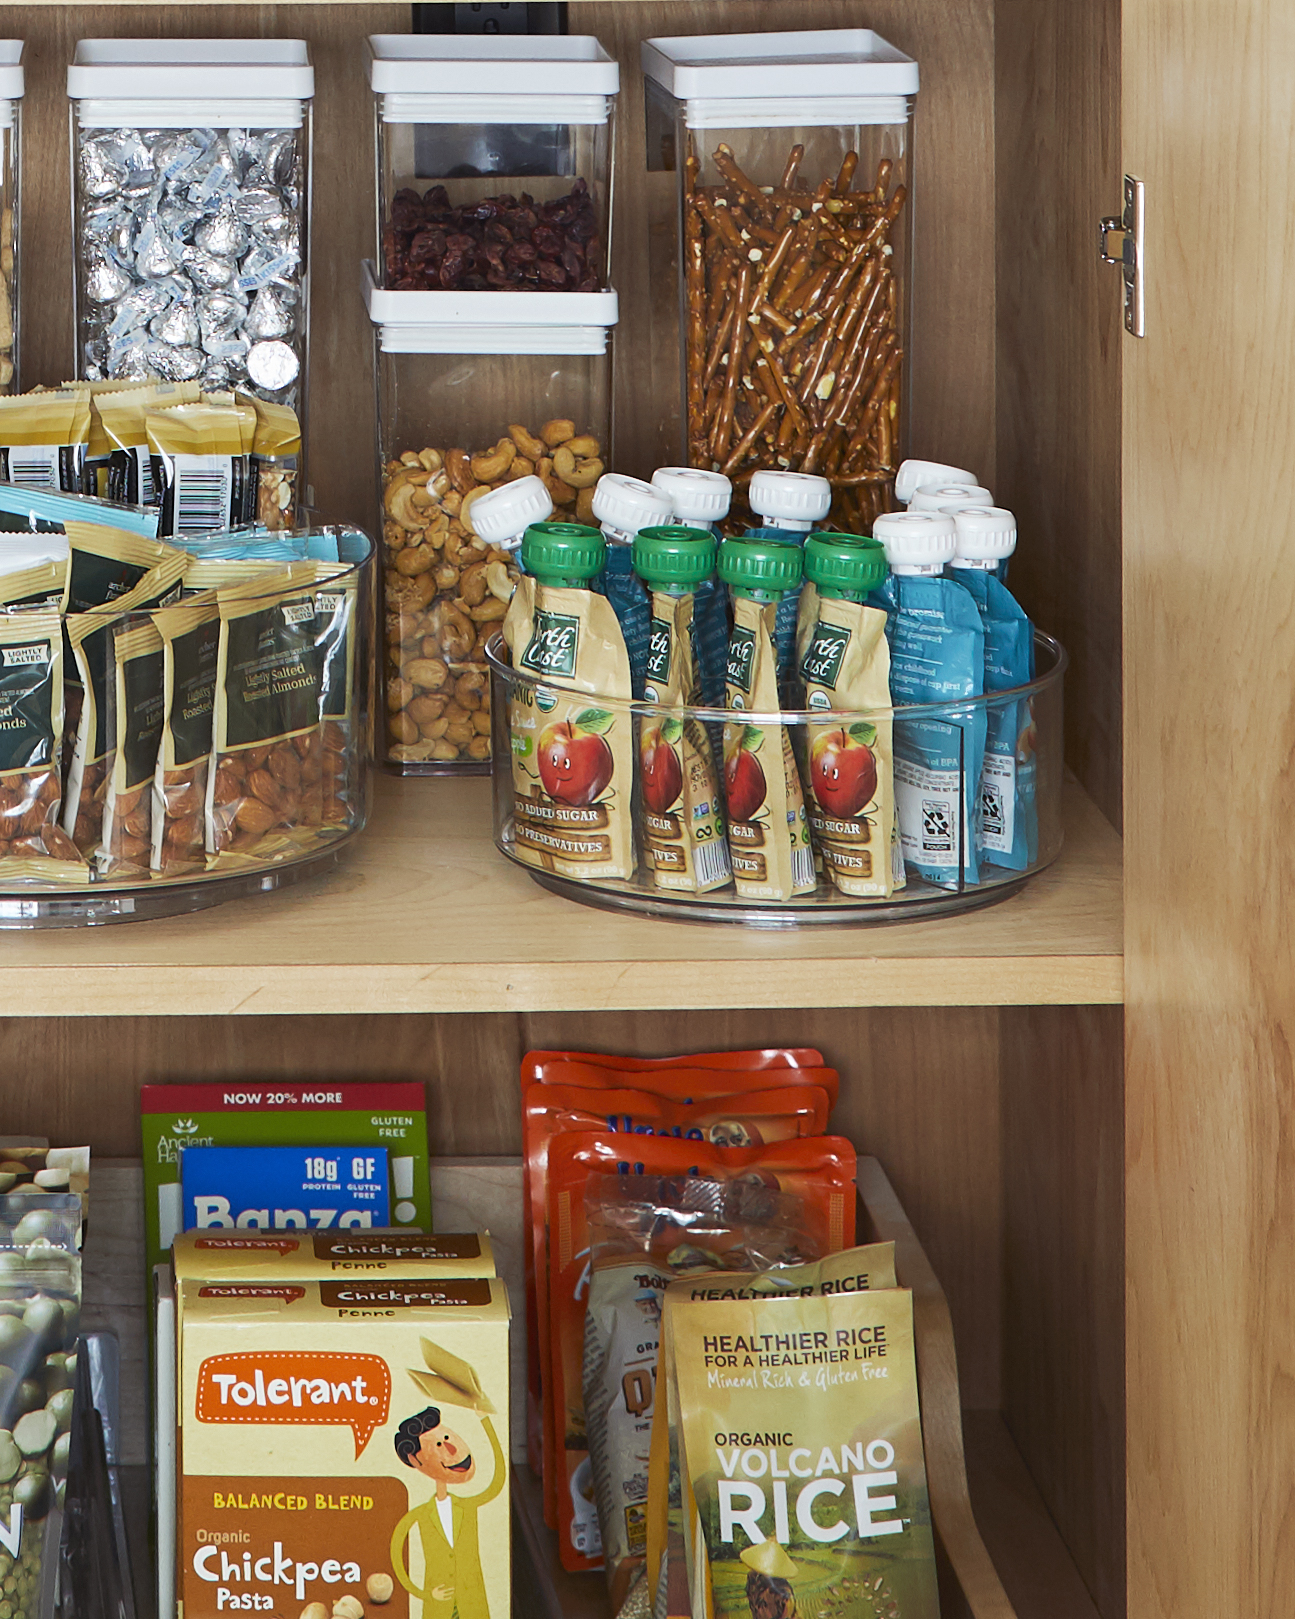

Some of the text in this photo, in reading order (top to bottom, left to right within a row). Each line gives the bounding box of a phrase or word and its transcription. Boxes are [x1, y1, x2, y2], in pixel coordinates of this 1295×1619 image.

[8, 647, 43, 658] LIGHTLY
[10, 655, 43, 664] SALTED
[271, 663, 306, 681] Salted
[940, 758, 959, 767] BPA
[556, 809, 599, 822] SUGAR
[525, 827, 603, 853] PRESERVATIVES
[223, 1092, 342, 1105] NOW 20% MORE
[370, 1116, 413, 1126] GLUTEN
[378, 1127, 407, 1138] FREE
[304, 1157, 375, 1182] 18g GF
[302, 1183, 341, 1191] PROTEIN
[347, 1183, 382, 1192] GLUTEN
[353, 1191, 376, 1200] FREE
[330, 1243, 437, 1258] Chickpea
[331, 1260, 388, 1271] Penne
[820, 1273, 870, 1296] RICE
[337, 1290, 446, 1304] Chickpea
[338, 1308, 396, 1318] Penne
[703, 1325, 886, 1353] HEALTHIER RICE
[705, 1344, 887, 1368] FOR A HEALTHIER LIFE
[707, 1362, 889, 1391] Mineral Rich & Gluten Free
[211, 1368, 368, 1407] Tolerant
[714, 1432, 794, 1447] ORGANIC
[716, 1438, 896, 1478] VOLCANO
[213, 1491, 374, 1512] BALANCED BLEND
[717, 1470, 904, 1546] RICE
[196, 1528, 251, 1544] Organic
[192, 1541, 361, 1600] Chickpea
[216, 1588, 274, 1611] Pasta
